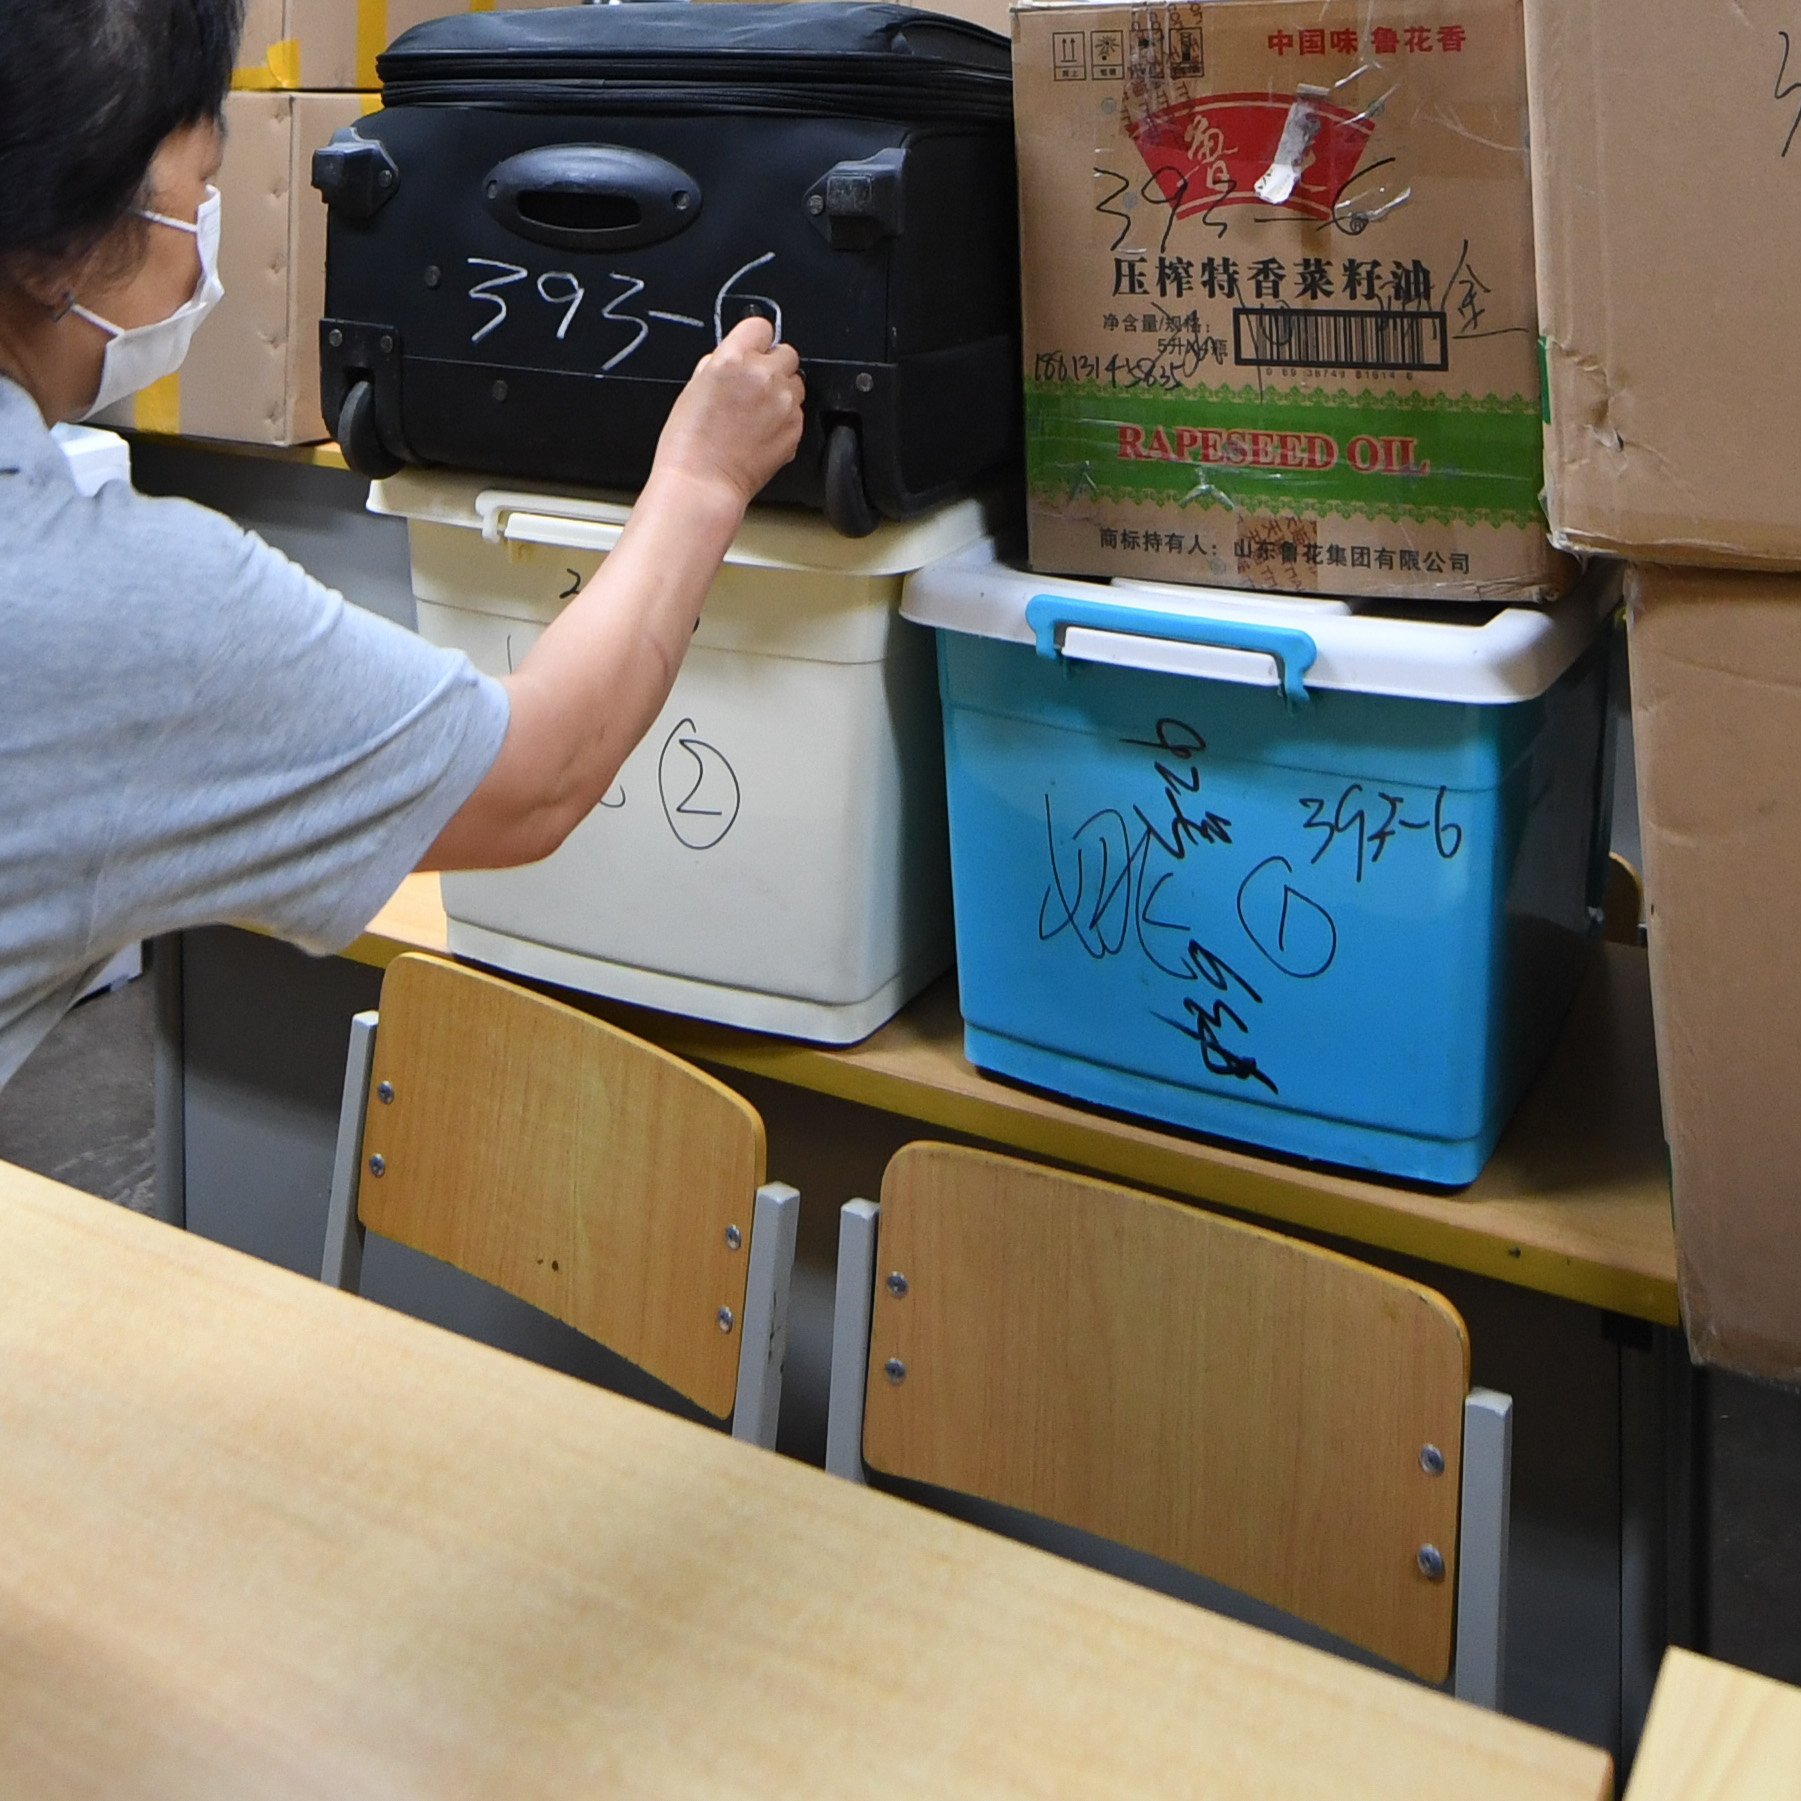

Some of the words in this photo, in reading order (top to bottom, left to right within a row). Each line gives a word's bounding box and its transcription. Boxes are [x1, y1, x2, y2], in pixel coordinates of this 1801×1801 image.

[1267, 28, 1359, 57] 中国味
[1369, 24, 1468, 56] 鲁花香
[1111, 256, 1432, 302] 压榨特香菜籽油
[466, 251, 784, 373] 393-6
[1116, 424, 1338, 471] RAPESEED
[1346, 434, 1432, 477] OIL
